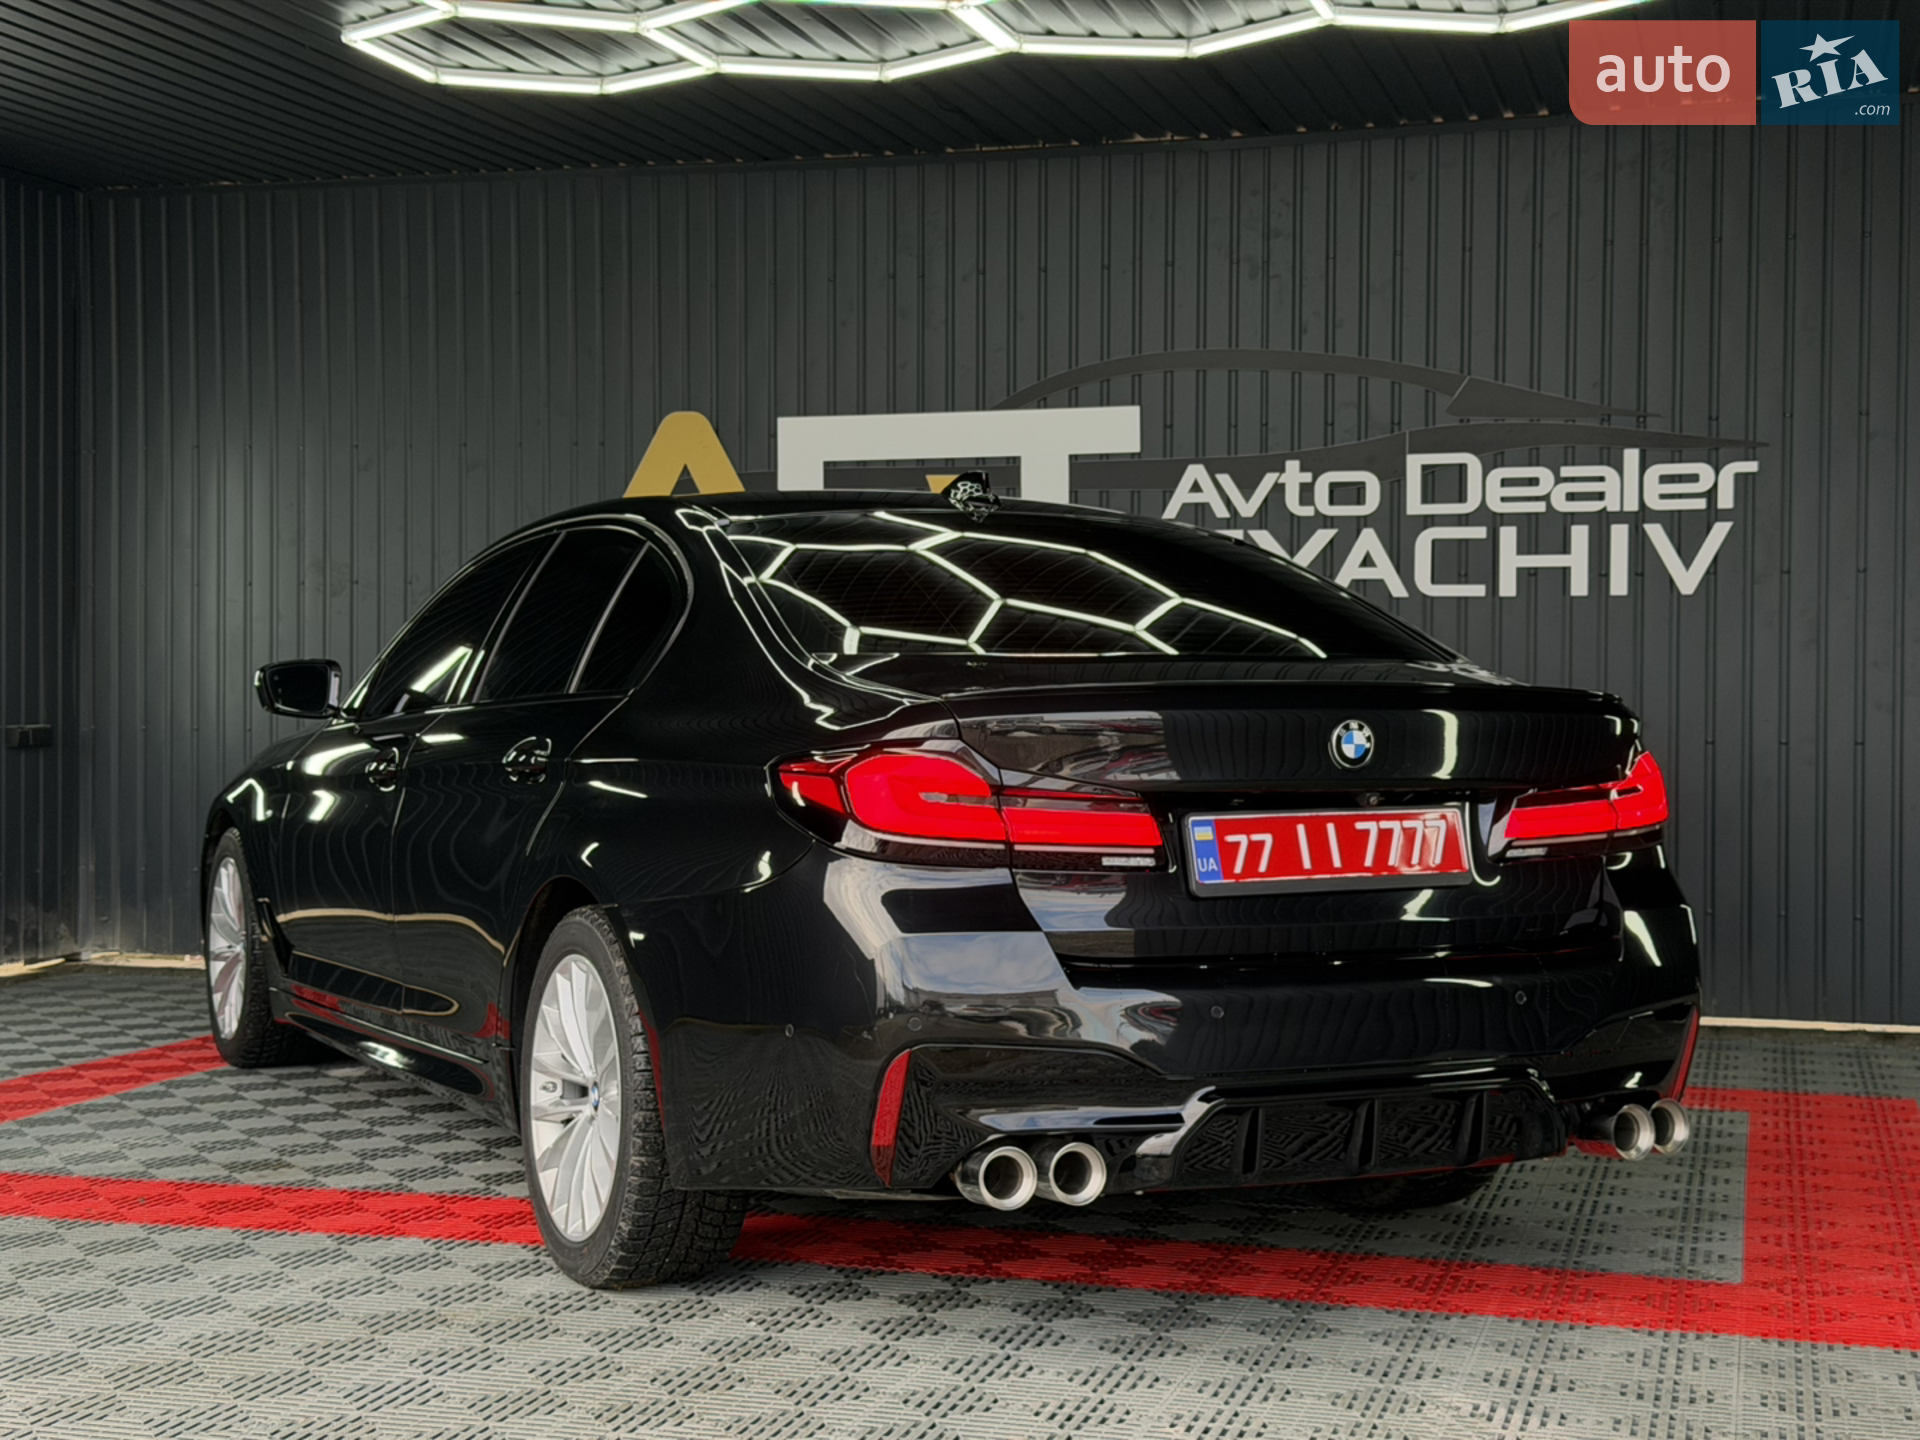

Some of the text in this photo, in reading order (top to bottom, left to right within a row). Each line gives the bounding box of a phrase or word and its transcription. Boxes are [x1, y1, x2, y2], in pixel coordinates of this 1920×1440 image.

[1161, 448, 1760, 519] Avto Dealer
[1214, 521, 1734, 598] YACHIV
[1196, 856, 1219, 873] UA
[1223, 834, 1273, 874] 77
[1354, 819, 1447, 868] 7777
